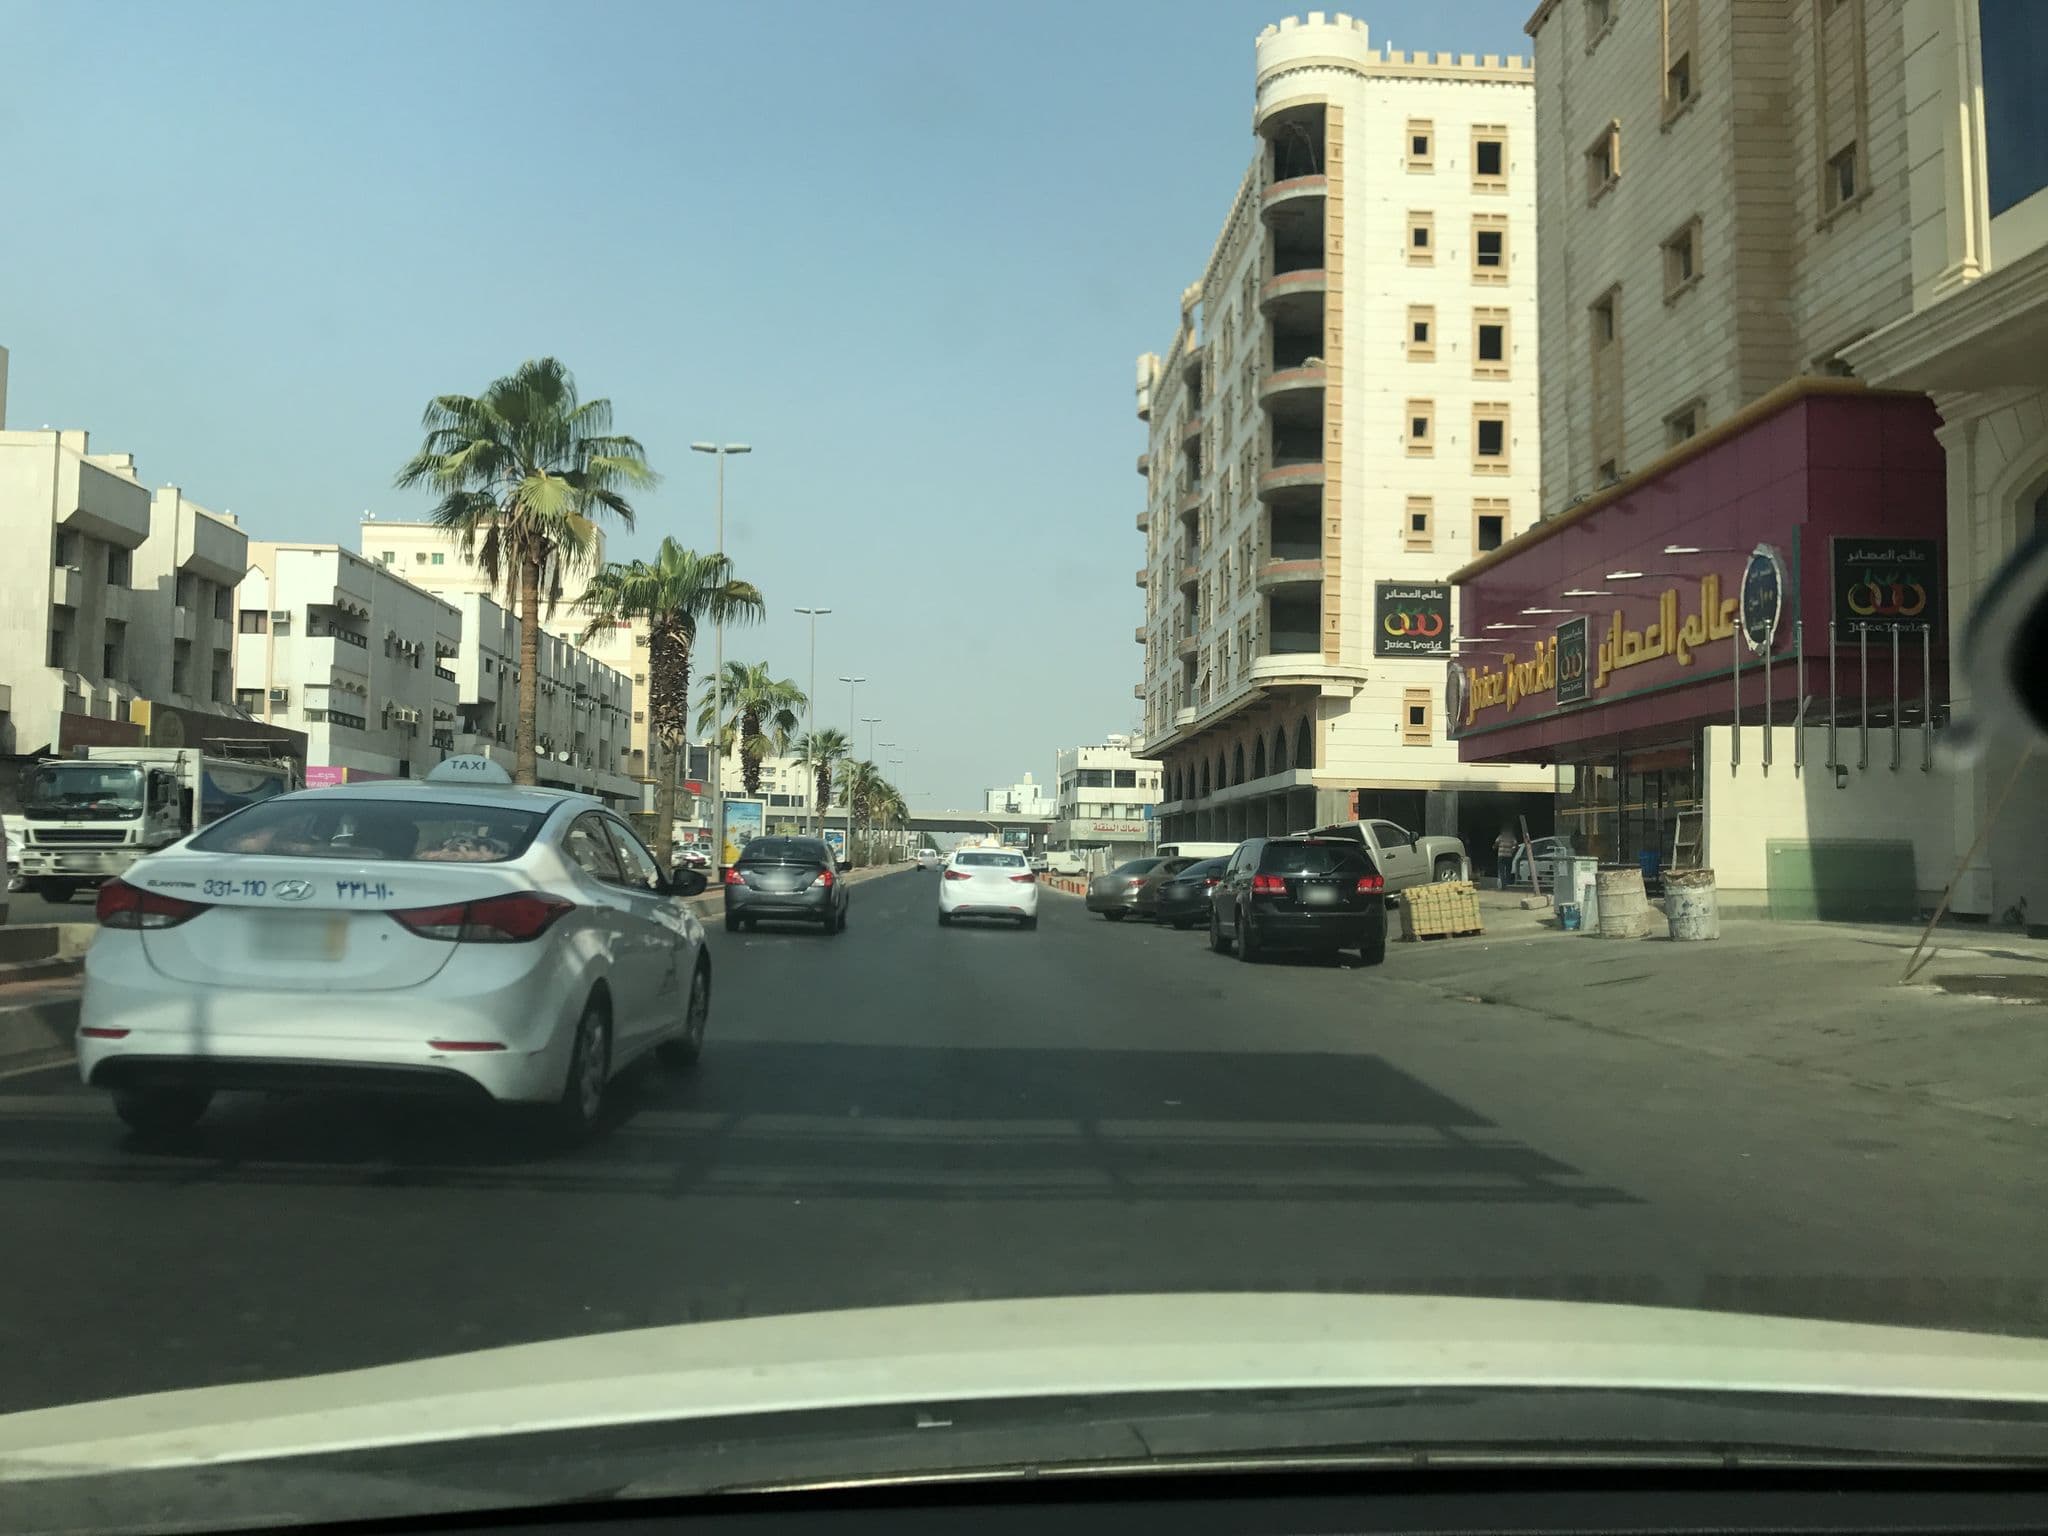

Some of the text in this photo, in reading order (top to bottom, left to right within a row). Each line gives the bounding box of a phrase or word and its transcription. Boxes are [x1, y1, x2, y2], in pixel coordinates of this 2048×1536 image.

[1384, 589, 1443, 600] عالم العصائر
[1677, 574, 1739, 666] عالم
[1384, 640, 1442, 651] Juice World
[1465, 665, 1506, 726] Juice
[451, 760, 486, 771] TAXI
[203, 879, 267, 897] 331-110
